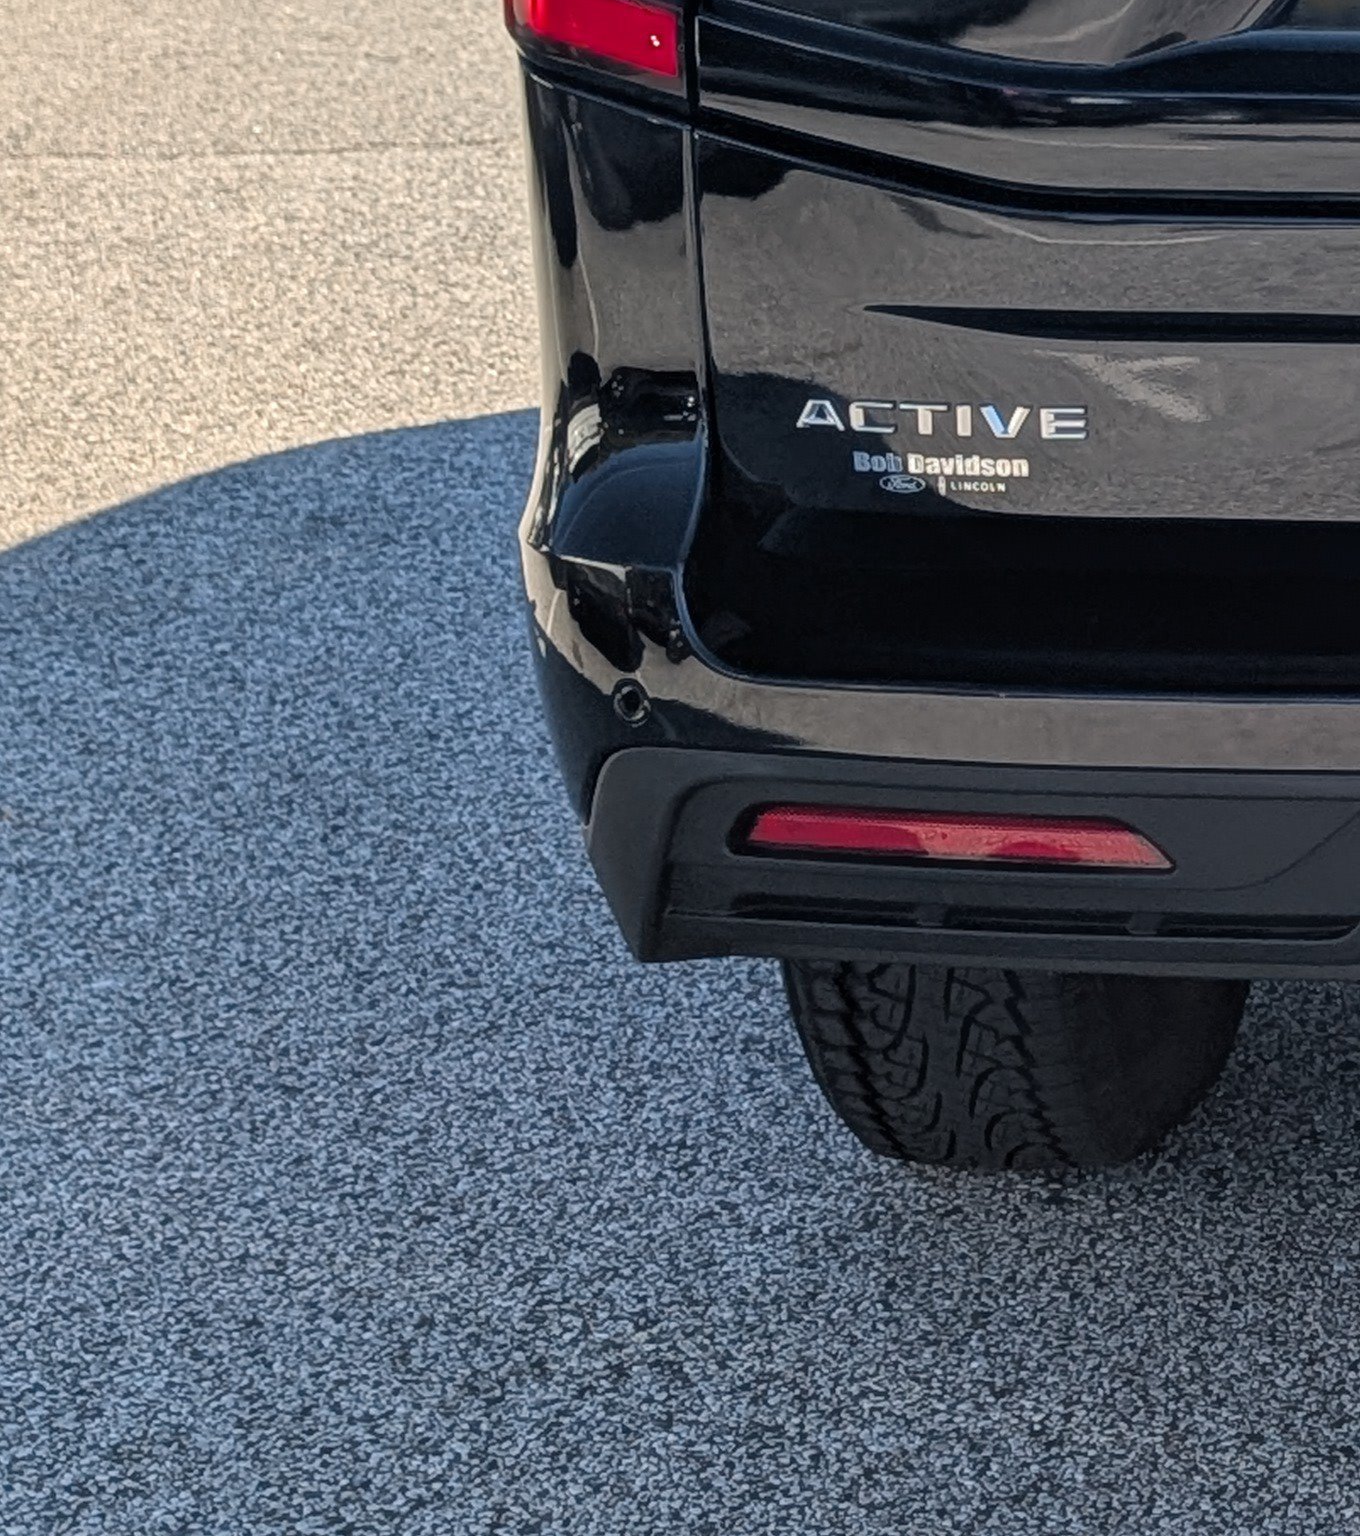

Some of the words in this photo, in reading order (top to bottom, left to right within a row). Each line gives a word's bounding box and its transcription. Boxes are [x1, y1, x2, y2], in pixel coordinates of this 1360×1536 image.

[796, 399, 1088, 440] ACTIVE
[853, 450, 903, 473] Bob
[906, 452, 1030, 477] Davidson
[950, 481, 1006, 493] LINCOLN
